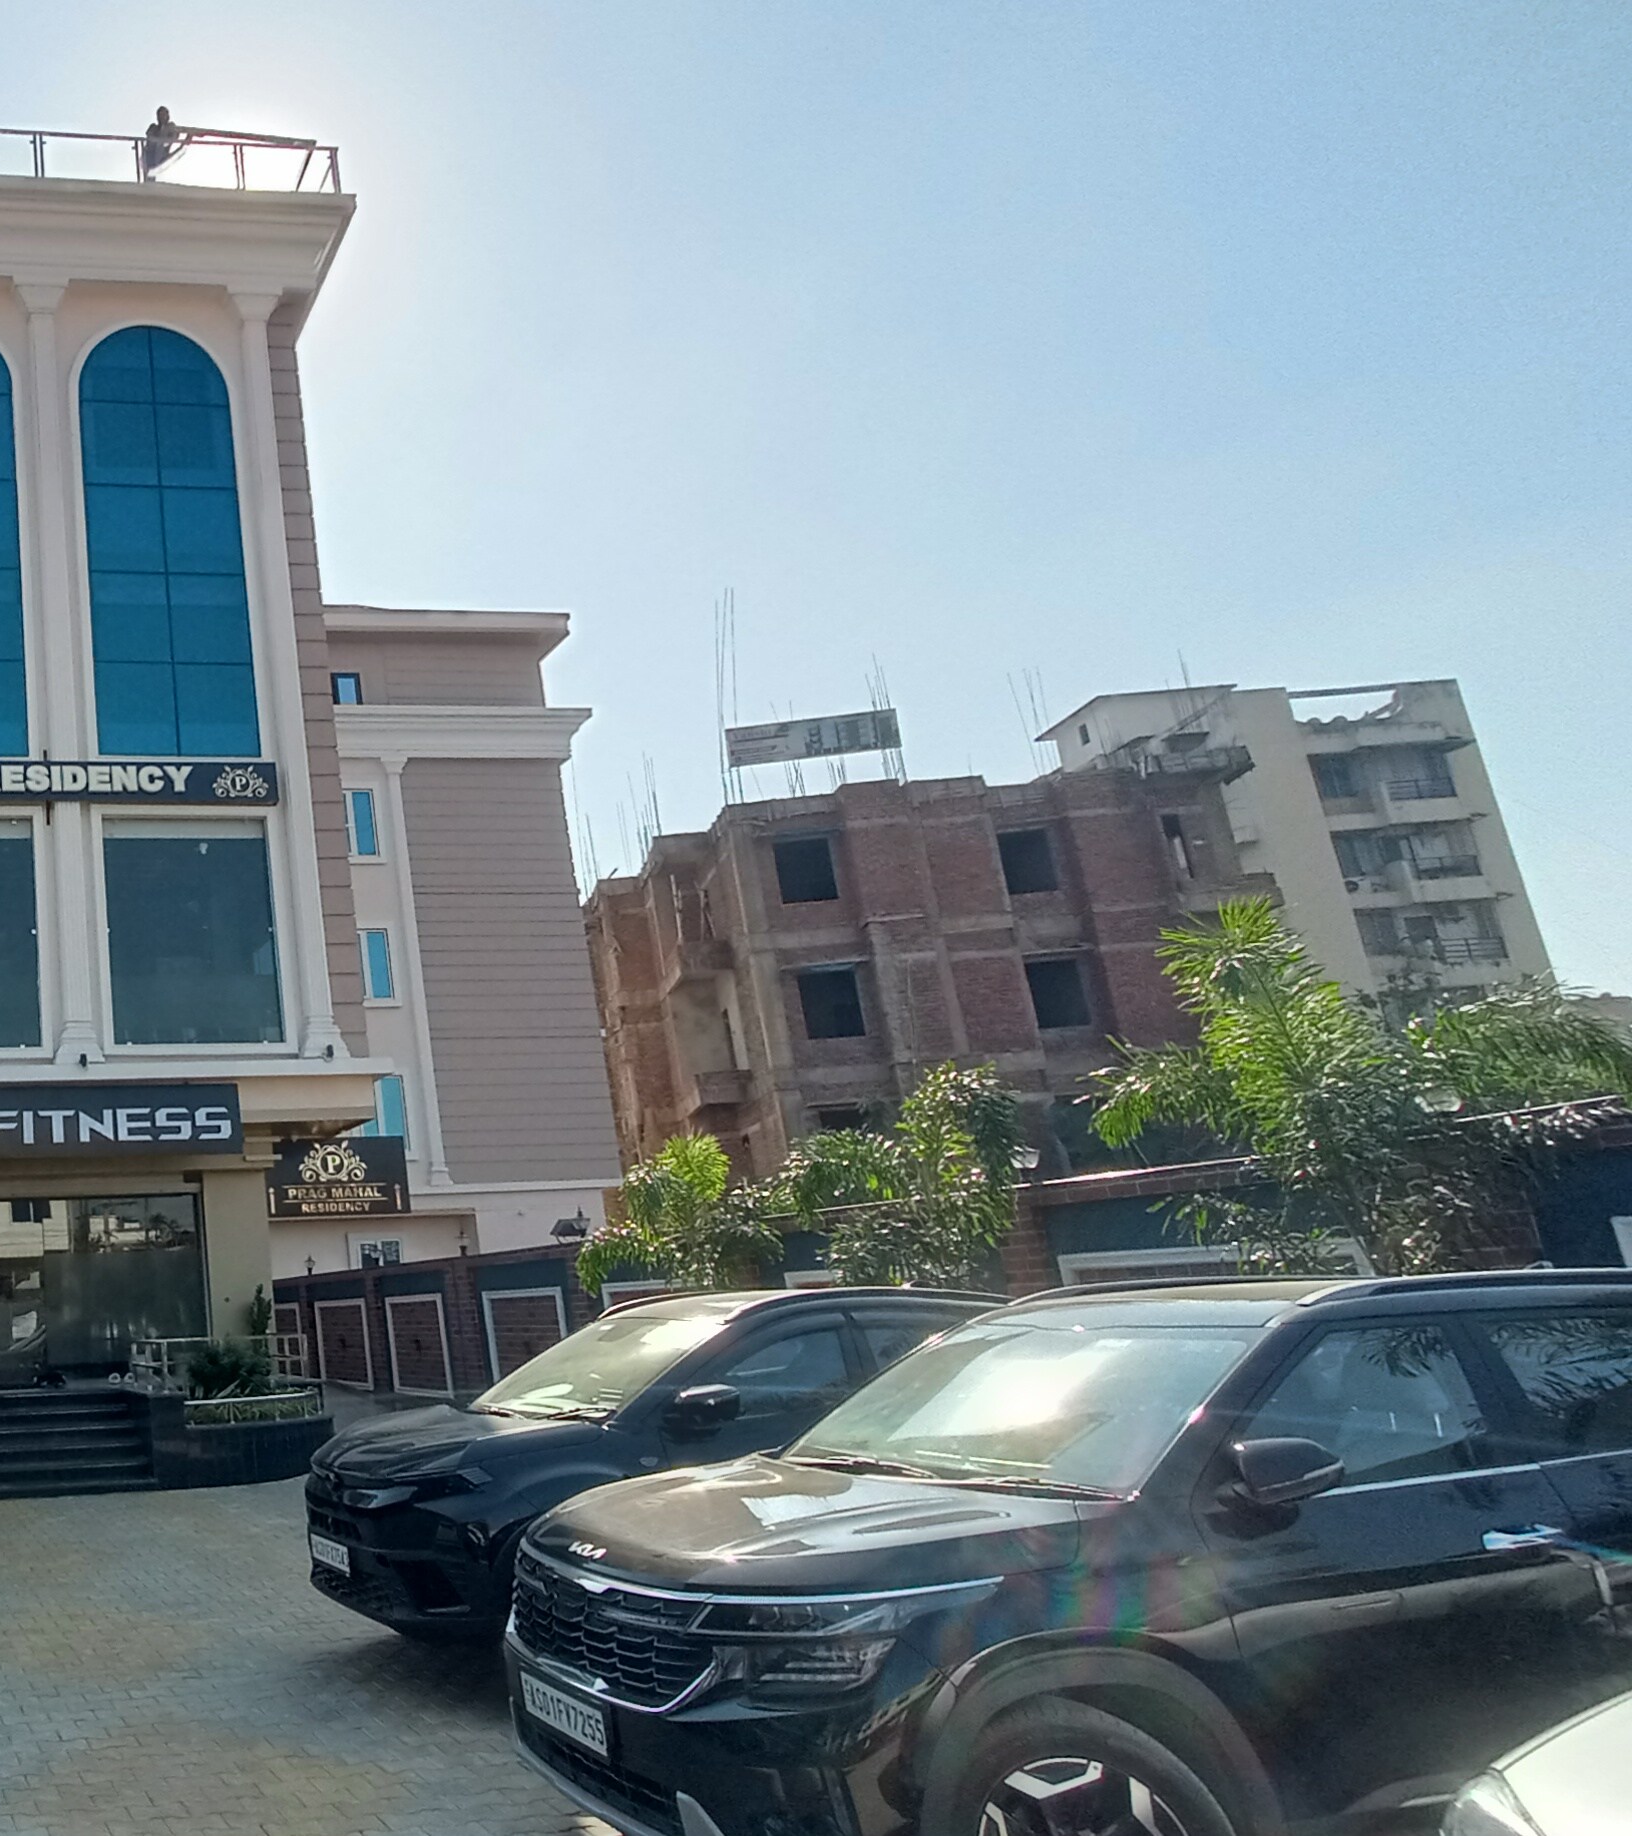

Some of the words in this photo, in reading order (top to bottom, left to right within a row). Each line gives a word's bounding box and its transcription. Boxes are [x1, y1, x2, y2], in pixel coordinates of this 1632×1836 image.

[287, 1187, 328, 1200] PRAG
[331, 1185, 382, 1199] MAHAL
[301, 1201, 371, 1214] RESIDENCY
